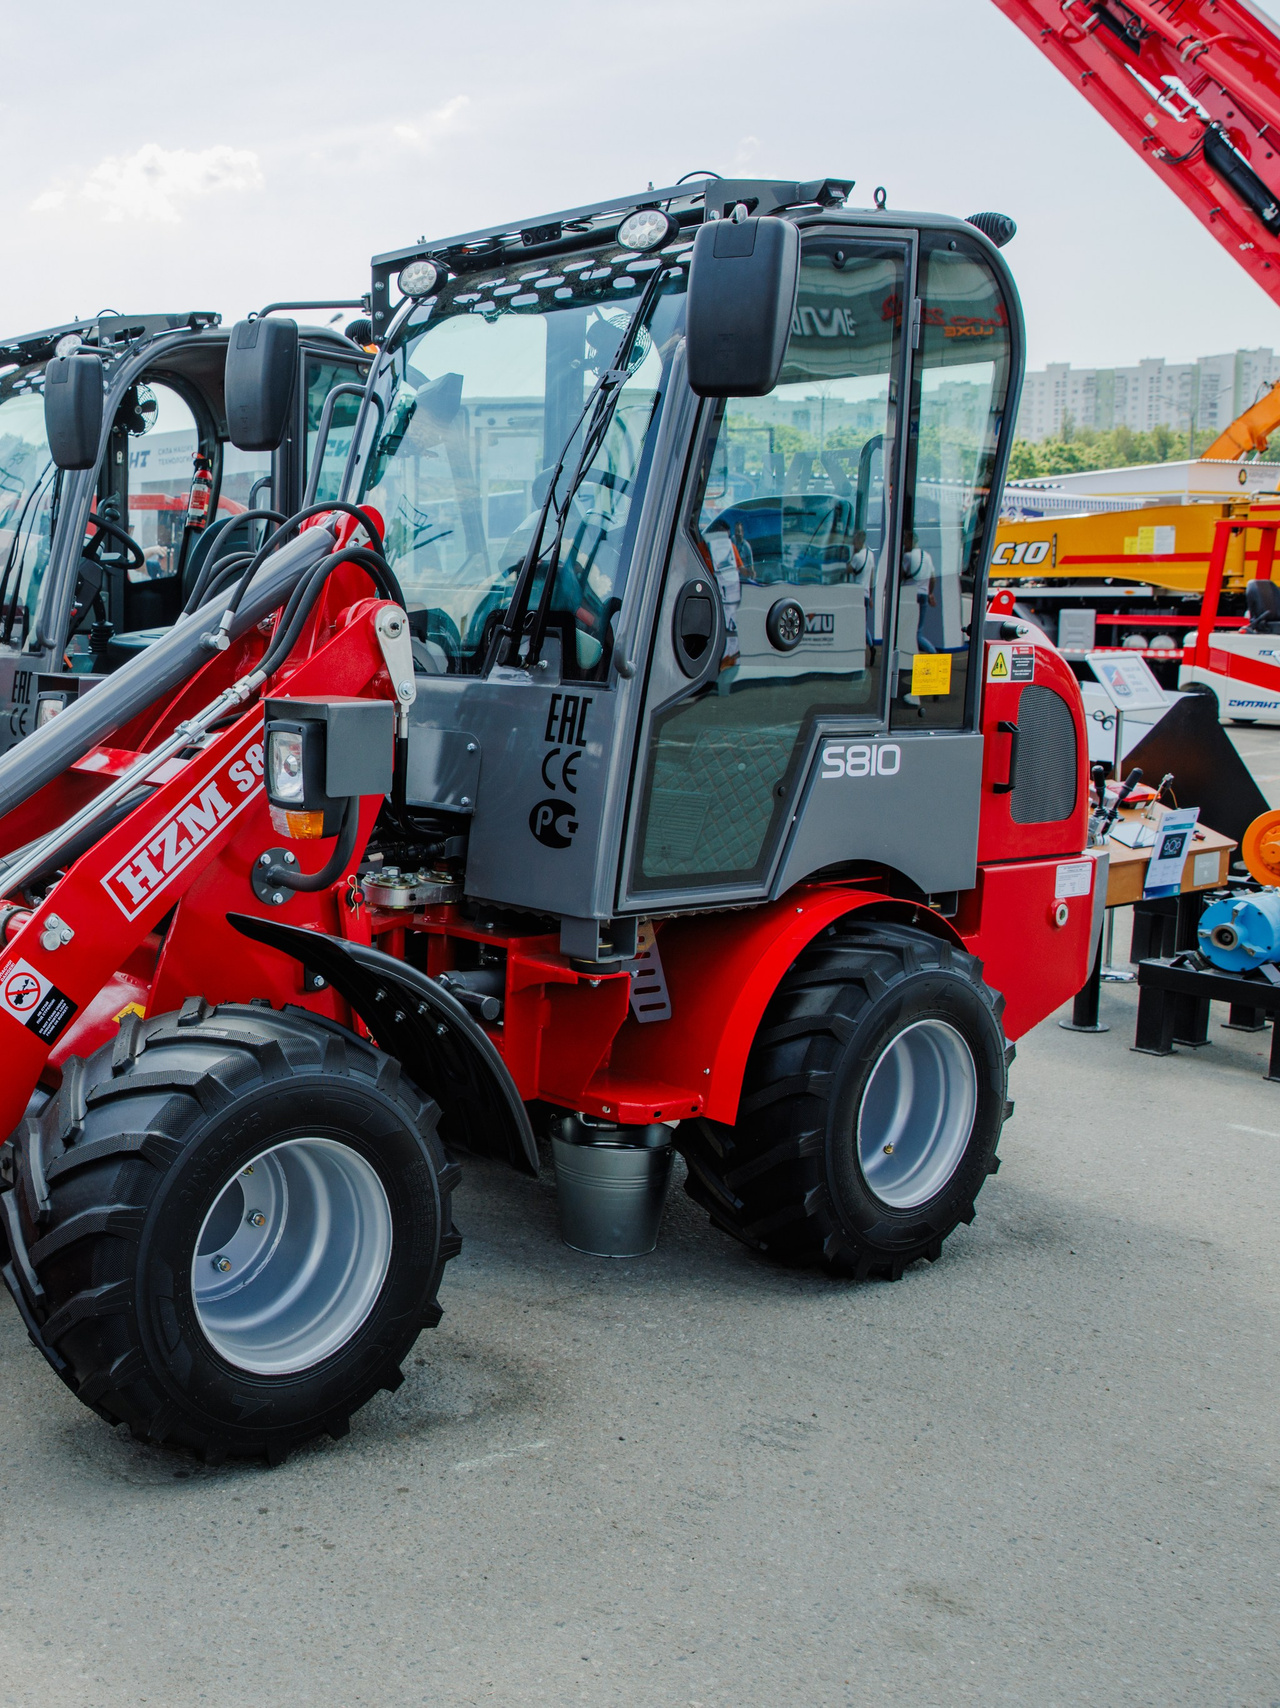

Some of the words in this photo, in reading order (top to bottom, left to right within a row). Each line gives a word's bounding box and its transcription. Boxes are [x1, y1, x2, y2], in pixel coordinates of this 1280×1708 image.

[545, 693, 593, 747] EAC
[542, 748, 582, 794] CE
[821, 744, 901, 779] S810
[115, 780, 233, 905] HZM
[228, 740, 264, 792] S8
